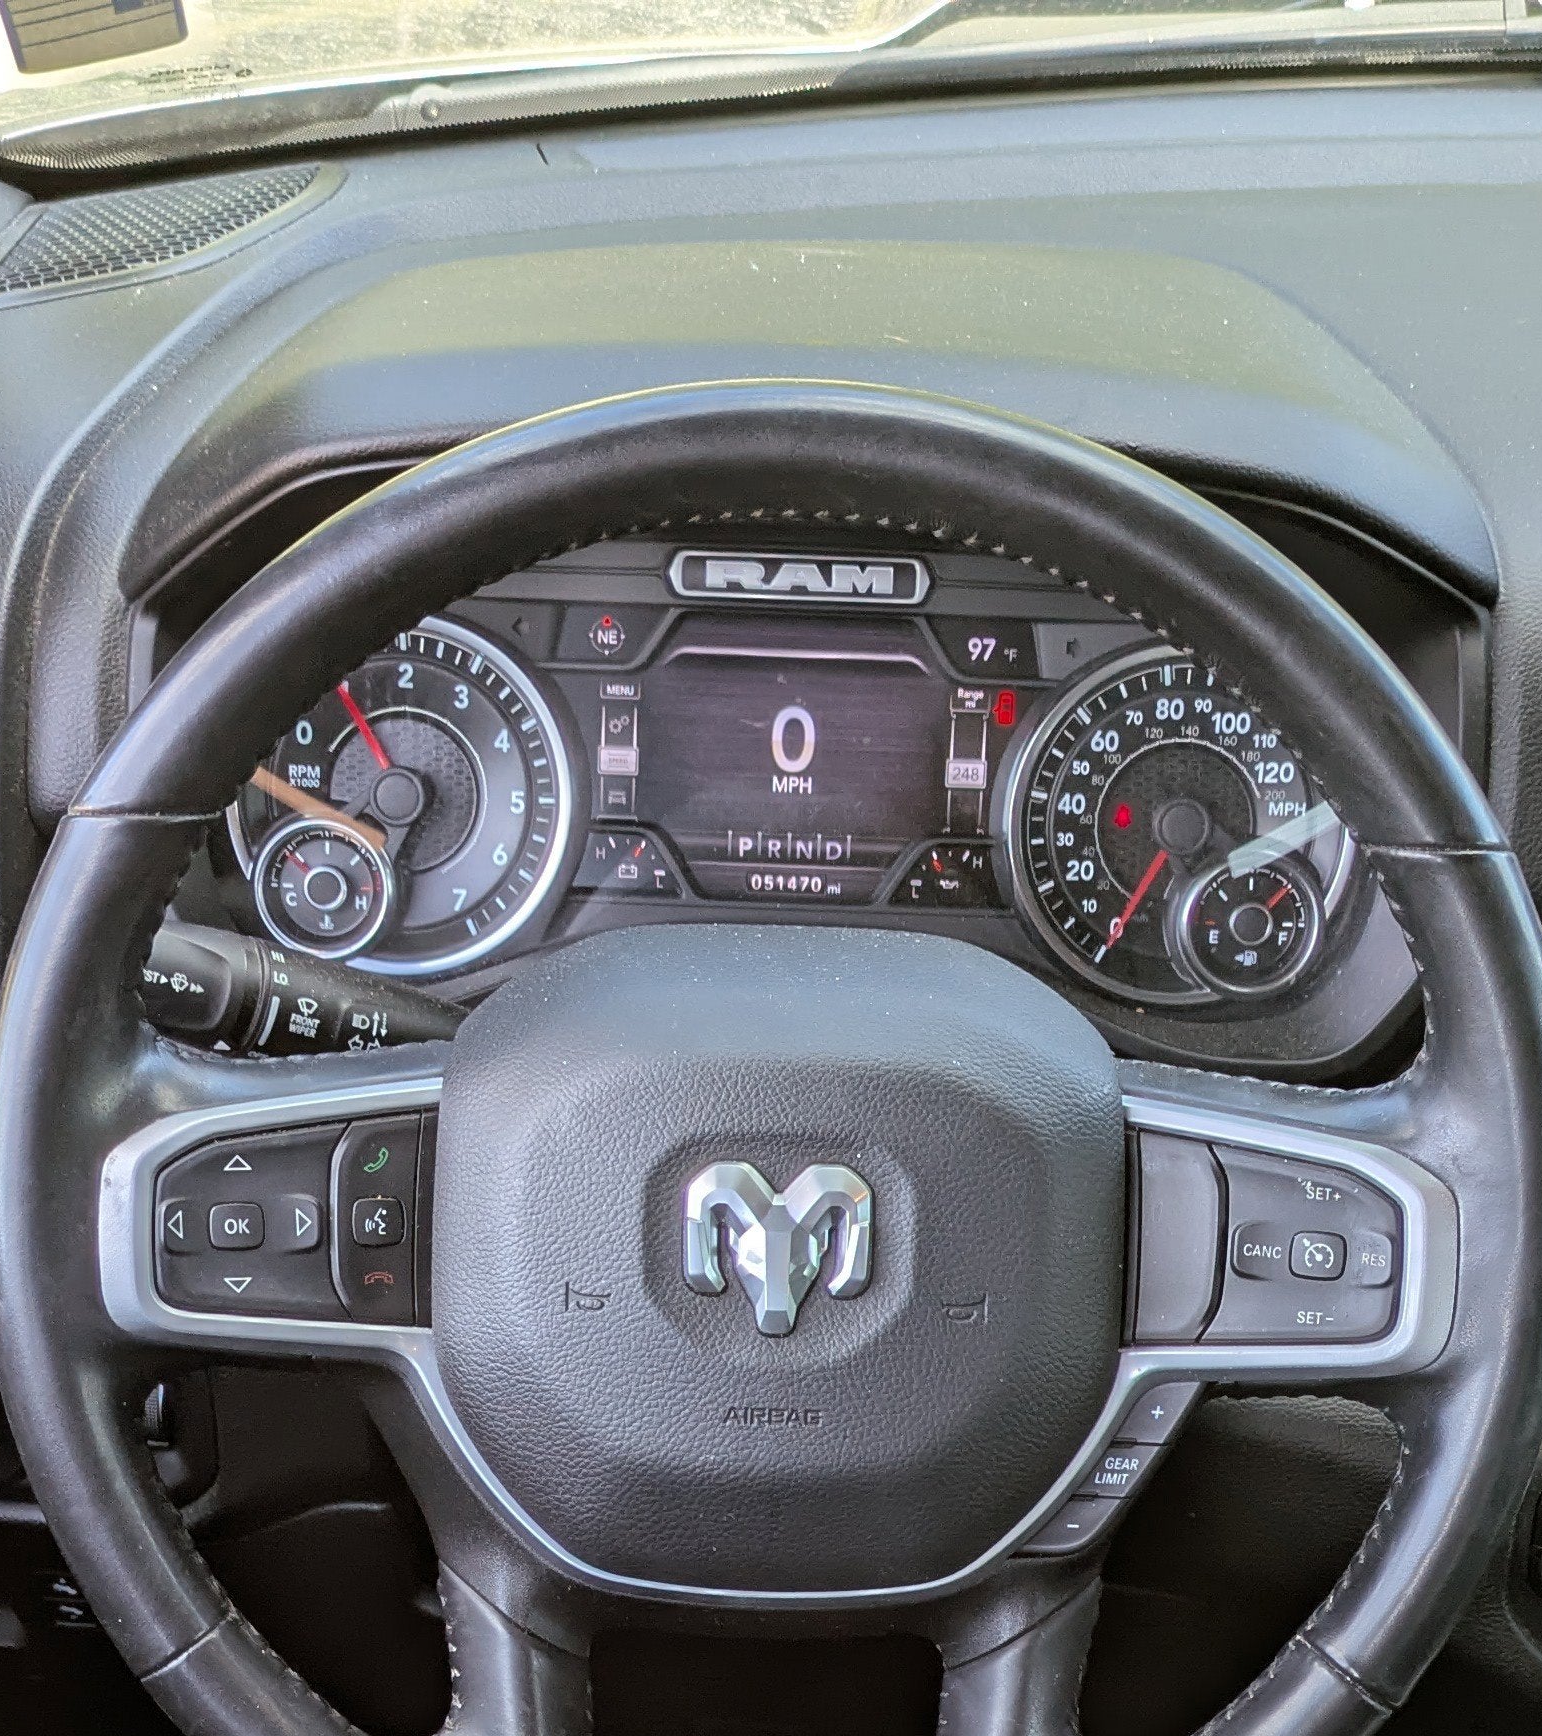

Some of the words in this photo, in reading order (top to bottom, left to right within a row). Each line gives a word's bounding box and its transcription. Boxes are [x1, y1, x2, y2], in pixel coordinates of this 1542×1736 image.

[705, 560, 894, 595] RAM
[597, 630, 618, 645] NE
[968, 637, 996, 661] 97
[398, 664, 414, 689] 2
[454, 685, 469, 709] 3
[606, 684, 634, 697] MENU
[957, 687, 984, 700] Range
[1155, 699, 1185, 721] 80
[1194, 699, 1212, 714] 90
[1126, 711, 1143, 726] 70
[1212, 712, 1250, 734] 100
[296, 720, 313, 745] 0
[1145, 727, 1163, 740] 120
[1180, 725, 1199, 737] 140
[494, 730, 510, 753] 4
[771, 706, 816, 772] 0
[1090, 731, 1119, 753] 60
[1218, 735, 1237, 747] 160
[1253, 734, 1277, 748] 110
[1103, 753, 1121, 765] 100
[1241, 751, 1260, 763] 180
[288, 764, 321, 780] RPM
[952, 766, 979, 782] 248
[1072, 761, 1089, 775] 50
[1255, 761, 1295, 784] 120
[772, 777, 812, 794] MPH
[1091, 775, 1105, 786] 80
[511, 791, 525, 815] 5
[1265, 790, 1285, 801] 200
[1058, 794, 1085, 815] 40
[1268, 801, 1307, 816] MPH
[1080, 814, 1093, 825] 60
[1056, 833, 1073, 847] 30
[493, 843, 508, 867] 6
[595, 847, 605, 860] H
[738, 836, 753, 857] P
[768, 839, 781, 858] R
[797, 839, 812, 859] N
[826, 840, 842, 860] D
[972, 856, 982, 869] H
[1067, 861, 1094, 882] 20
[751, 874, 822, 893] 051470
[827, 881, 841, 896] mi
[286, 891, 298, 907] C
[355, 896, 367, 911] H
[453, 889, 468, 912] 7
[1082, 899, 1097, 913] 10
[1209, 930, 1219, 944] E
[1278, 932, 1287, 946] F
[271, 951, 285, 963] HI
[274, 972, 288, 986] LO
[290, 1014, 320, 1028] FRONT
[289, 1024, 316, 1038] WIPER
[224, 1219, 250, 1235] OK
[1243, 1243, 1282, 1260] CANC
[1361, 1251, 1386, 1268] RES
[723, 1407, 823, 1428] AIRBAG
[1105, 1457, 1138, 1471] GEAR
[1095, 1472, 1128, 1486] LIMIT
